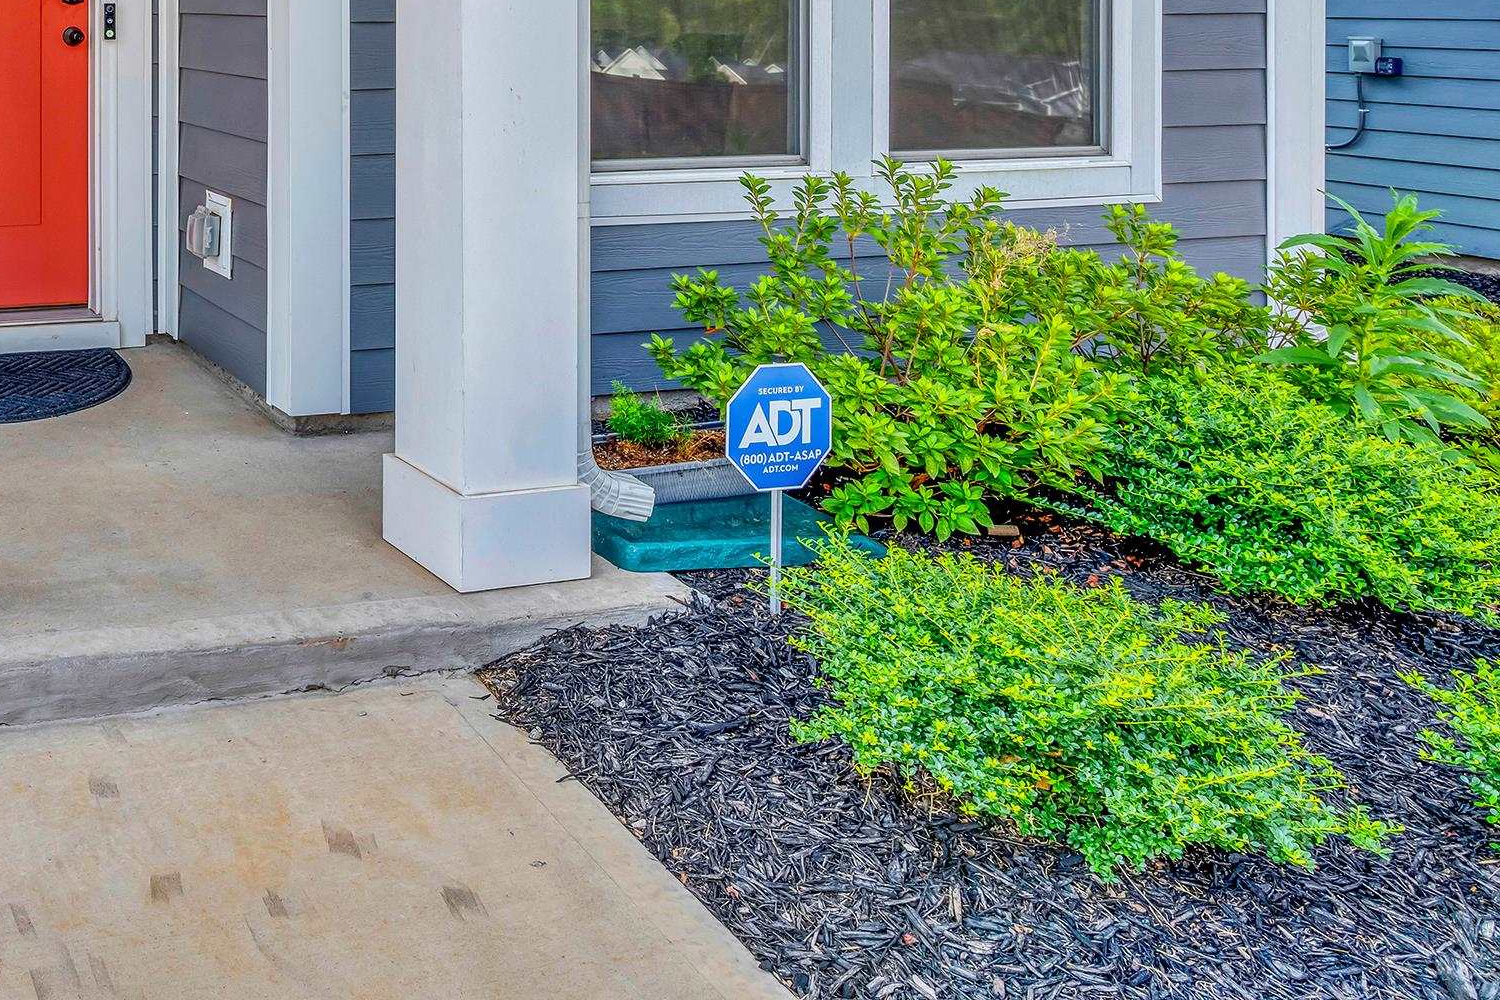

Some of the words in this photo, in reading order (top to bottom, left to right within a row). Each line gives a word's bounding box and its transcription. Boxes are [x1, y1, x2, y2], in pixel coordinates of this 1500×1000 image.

[758, 386, 793, 395] SECURED
[794, 385, 804, 393] BY
[738, 398, 822, 449] ADT
[740, 453, 767, 466] (800)
[768, 449, 822, 463] ADT-ASAP
[762, 464, 799, 474] ADT.COM
